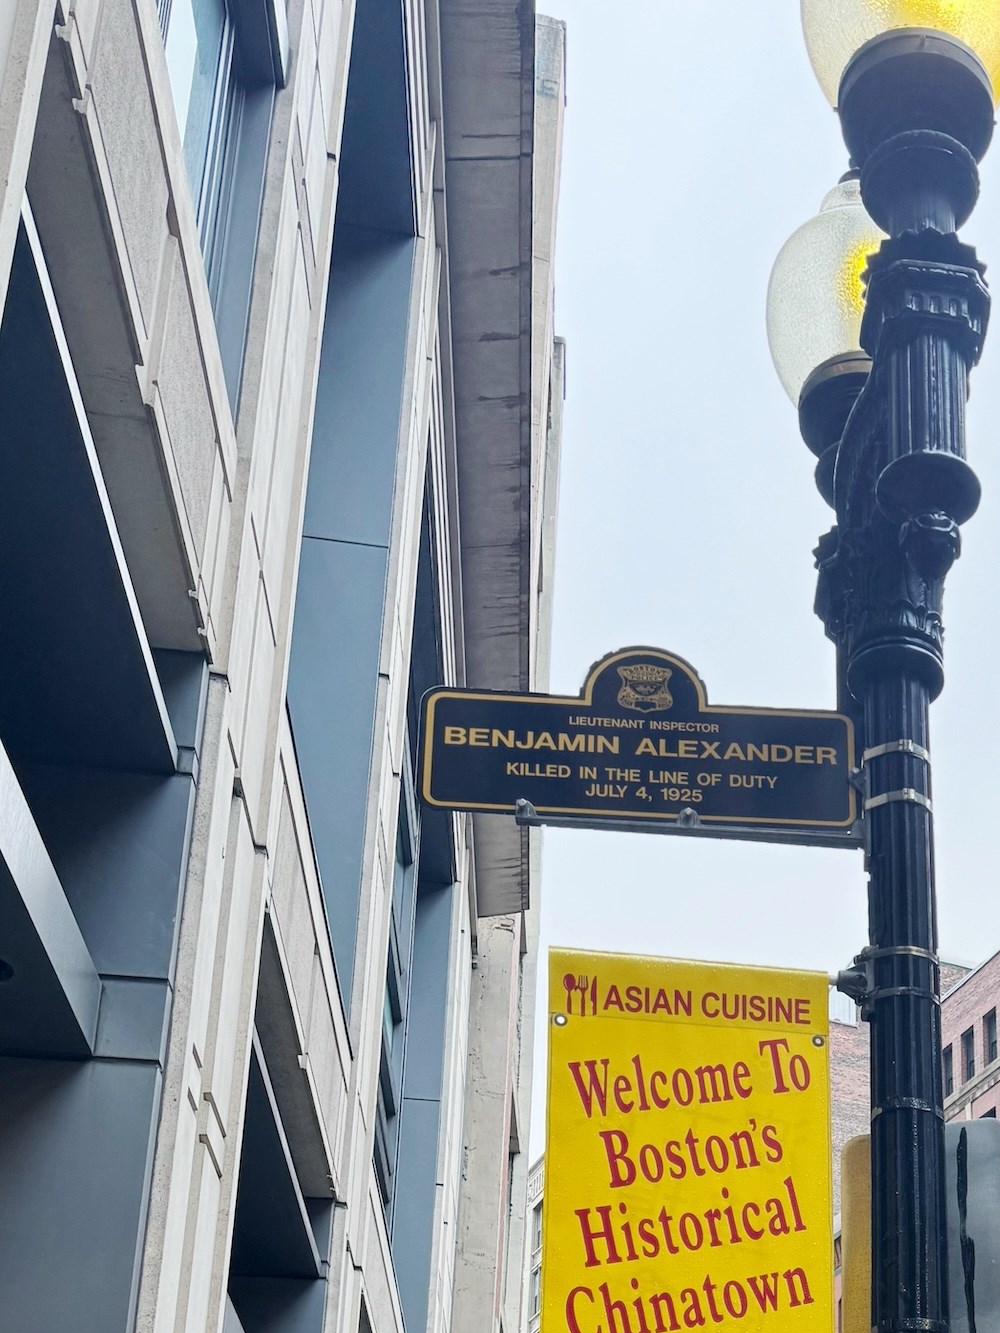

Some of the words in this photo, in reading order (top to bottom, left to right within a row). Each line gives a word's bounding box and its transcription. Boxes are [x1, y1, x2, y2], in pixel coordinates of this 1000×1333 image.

[569, 716, 645, 729] LIEUTENANT
[650, 721, 719, 733] INSPECTOR
[444, 726, 620, 754] BENJAMIN
[635, 737, 838, 765] ALEXANDER
[506, 762, 571, 778] KILLED
[579, 766, 598, 780] IN
[605, 767, 641, 782] THE
[649, 770, 689, 785] LINE
[697, 772, 722, 786] OF
[729, 774, 778, 789] DUTY
[585, 784, 628, 798] JULY
[635, 786, 653, 801] 4,
[660, 788, 703, 802] 1925
[603, 985, 692, 1017] ASIAN
[701, 992, 811, 1025] CUISINE
[568, 1054, 753, 1119] Welcome
[758, 1038, 811, 1094] To
[574, 1176, 807, 1268] Historical
